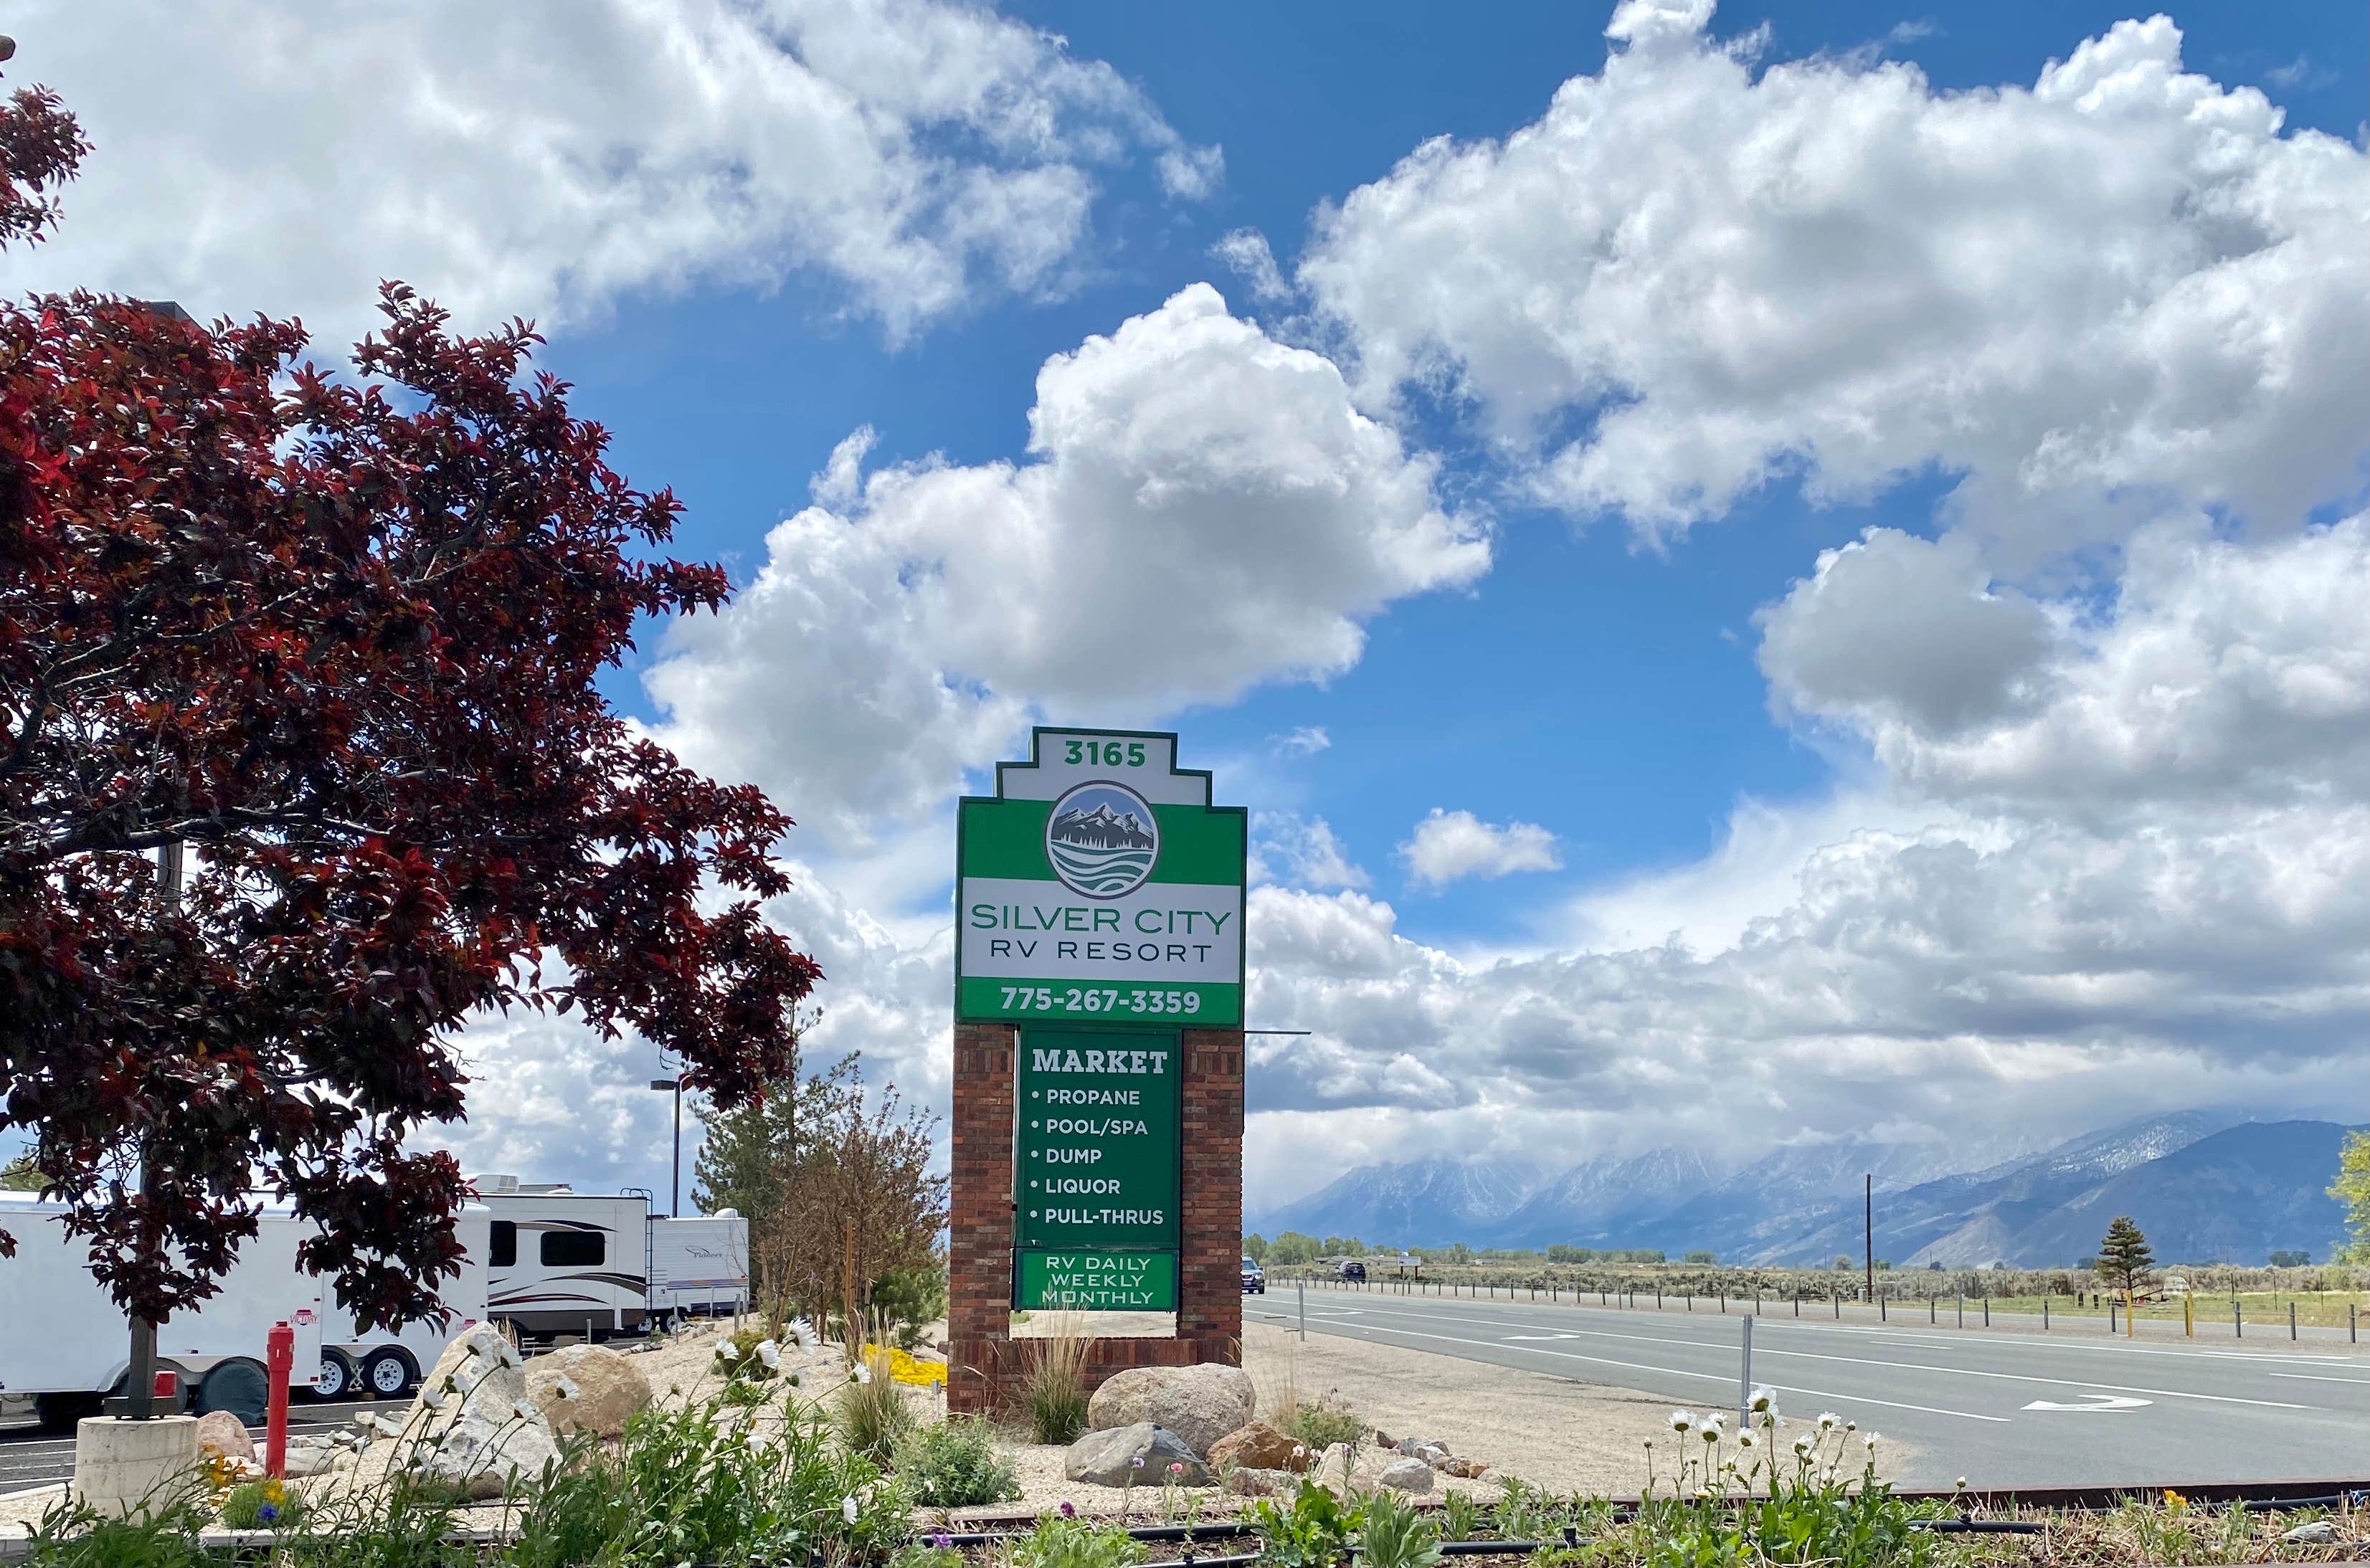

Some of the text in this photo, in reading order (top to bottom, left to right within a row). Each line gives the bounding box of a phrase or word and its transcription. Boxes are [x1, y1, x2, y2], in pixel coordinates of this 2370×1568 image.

[1065, 741, 1145, 766] 3165
[971, 904, 1232, 935] SILVER CITY
[990, 940, 1212, 963] RV RESORT
[1001, 987, 1200, 1014] 775-267-3359
[1032, 1049, 1168, 1074] MARKET
[1047, 1089, 1140, 1106] PROPANE
[1046, 1118, 1148, 1136] POOL/SPA
[1046, 1149, 1102, 1164] DUMP
[1046, 1179, 1121, 1194] LIQUOR
[1045, 1209, 1164, 1225] PULL-THRUS
[1046, 1257, 1151, 1270] RV DAILY
[1051, 1273, 1144, 1287] WEEKLY
[1042, 1291, 1154, 1304] MONTHLY
[290, 1314, 318, 1324] VICTORY
